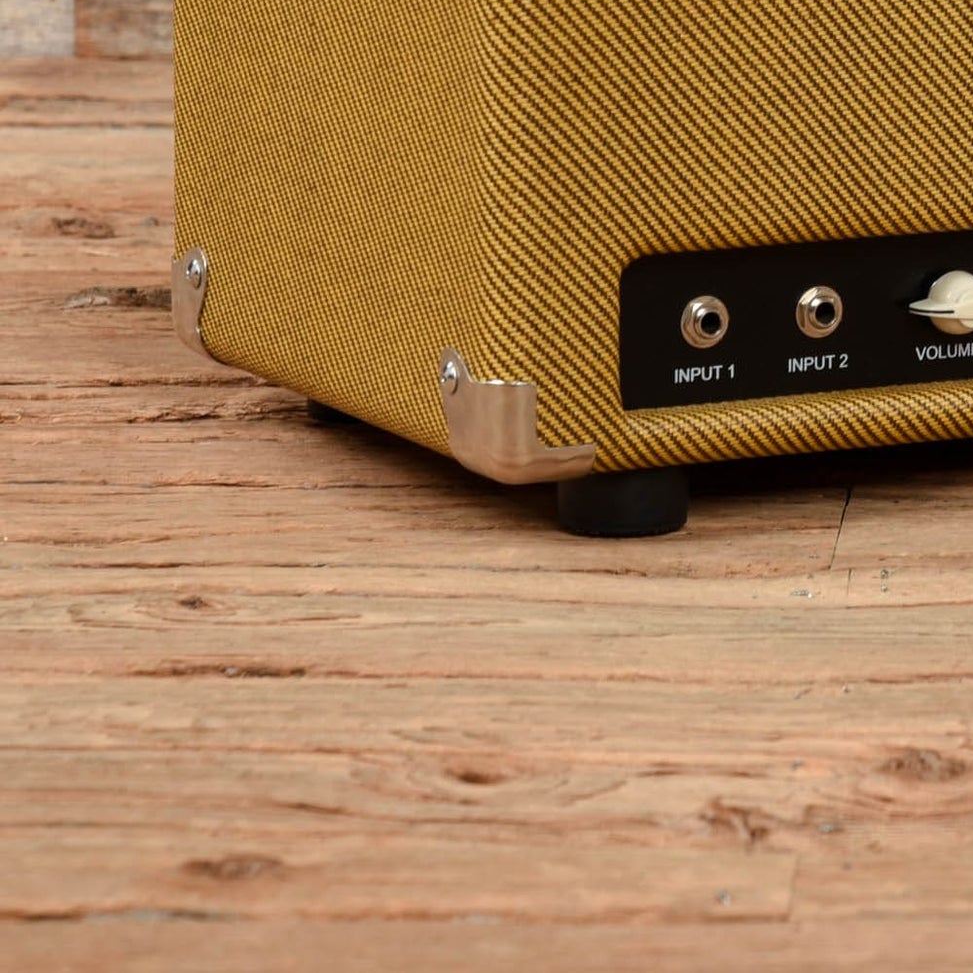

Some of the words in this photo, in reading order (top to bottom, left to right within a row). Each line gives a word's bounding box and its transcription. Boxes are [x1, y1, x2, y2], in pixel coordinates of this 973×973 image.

[787, 355, 834, 373] INPUT
[838, 353, 849, 369] 2
[673, 366, 724, 384] INPUT
[728, 363, 736, 379] 1
